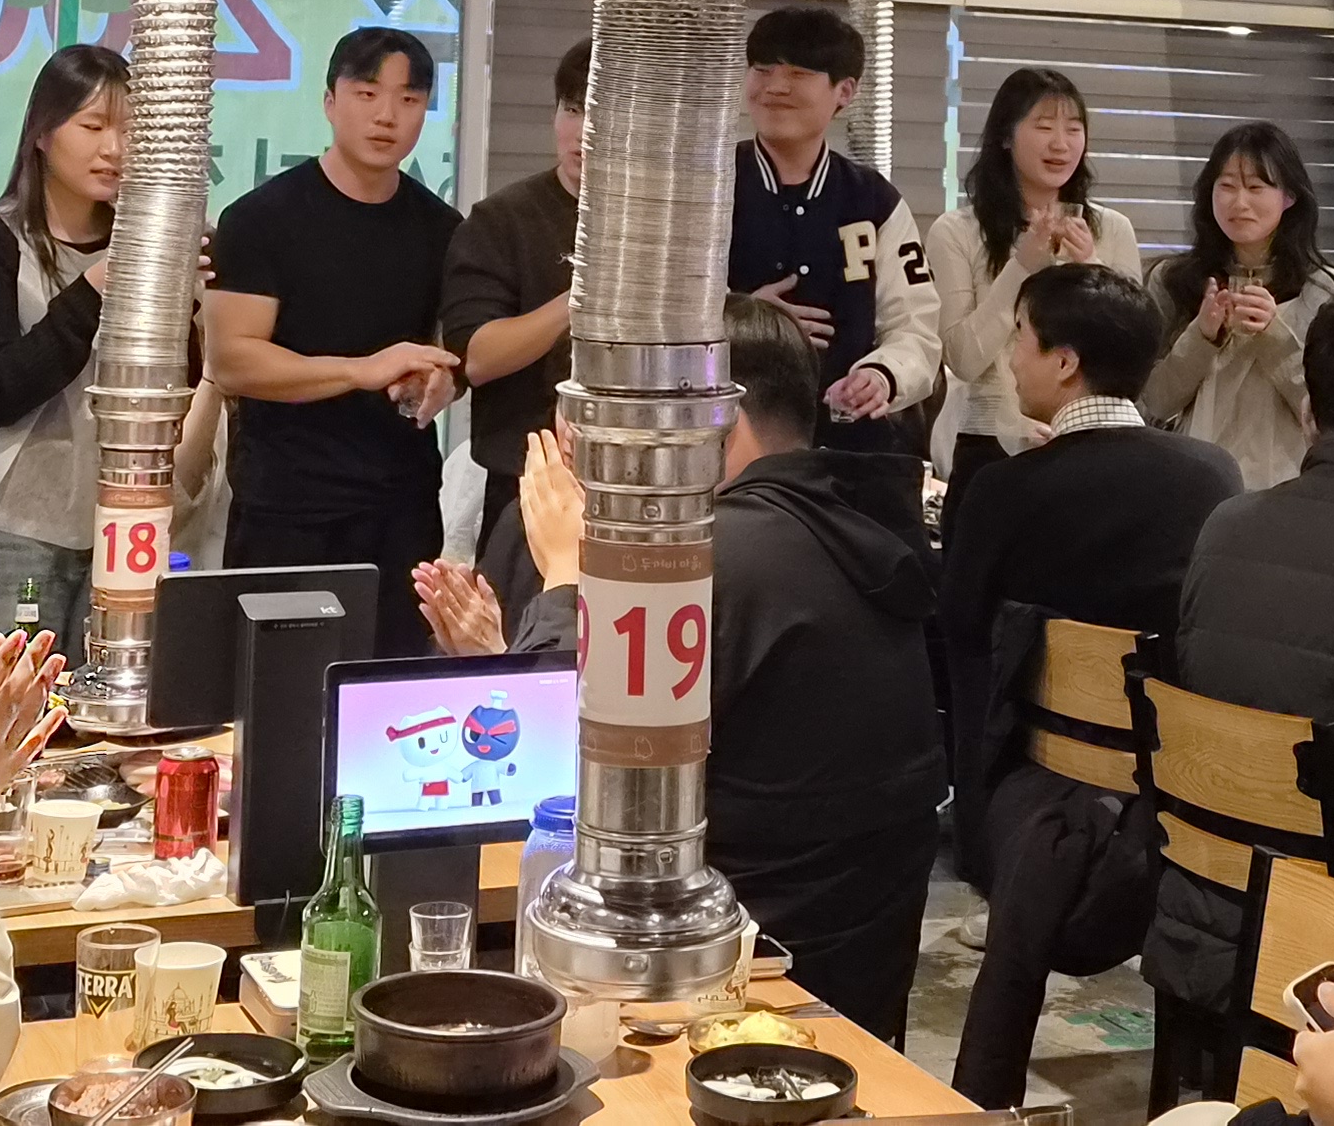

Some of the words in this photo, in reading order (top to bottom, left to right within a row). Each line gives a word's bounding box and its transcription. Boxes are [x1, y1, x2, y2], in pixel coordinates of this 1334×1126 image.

[838, 220, 876, 282] P
[898, 241, 935, 286] 2
[102, 521, 157, 574] 18
[320, 606, 338, 614] kt
[613, 604, 707, 702] 19
[78, 972, 134, 999] TERRA
